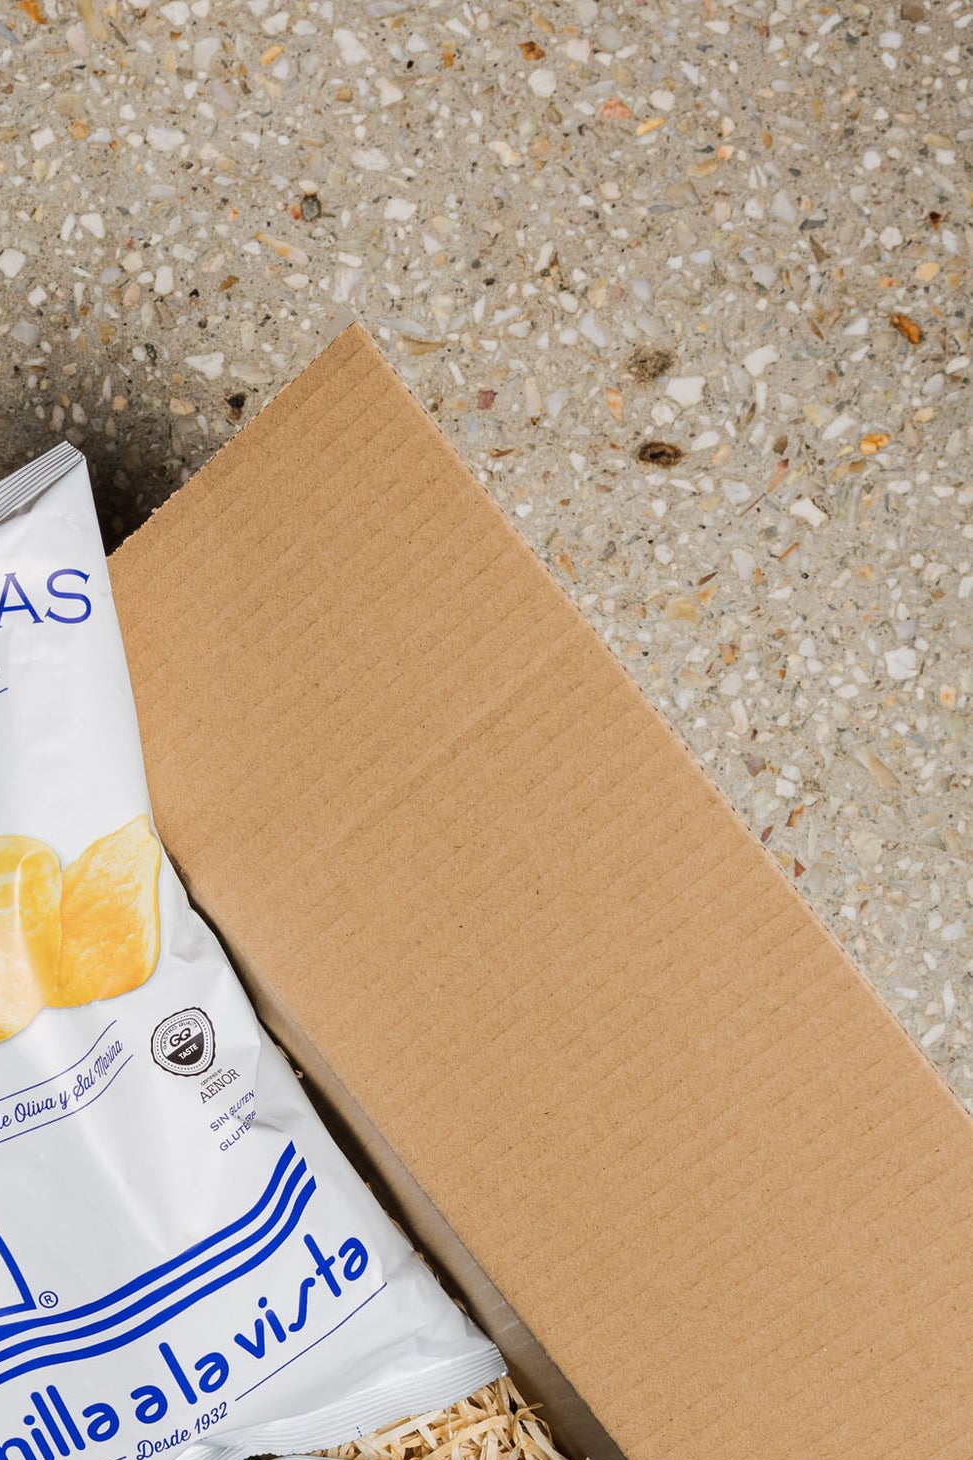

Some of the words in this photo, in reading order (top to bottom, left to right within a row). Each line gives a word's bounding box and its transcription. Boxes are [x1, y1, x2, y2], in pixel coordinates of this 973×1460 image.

[169, 1027, 192, 1047] GQ
[178, 1043, 199, 1060] TASTE
[14, 1096, 57, 1123] Oliva
[58, 1091, 70, 1109] y
[72, 1068, 96, 1101] Sal
[94, 1040, 123, 1078] Marina
[199, 1068, 241, 1104] AENOR
[209, 1112, 230, 1132] SIN
[229, 1089, 255, 1116] GLUTEN
[129, 1388, 168, 1424] a
[159, 1342, 230, 1404] la
[233, 1232, 370, 1360] vista
[193, 1401, 229, 1438] 1932
